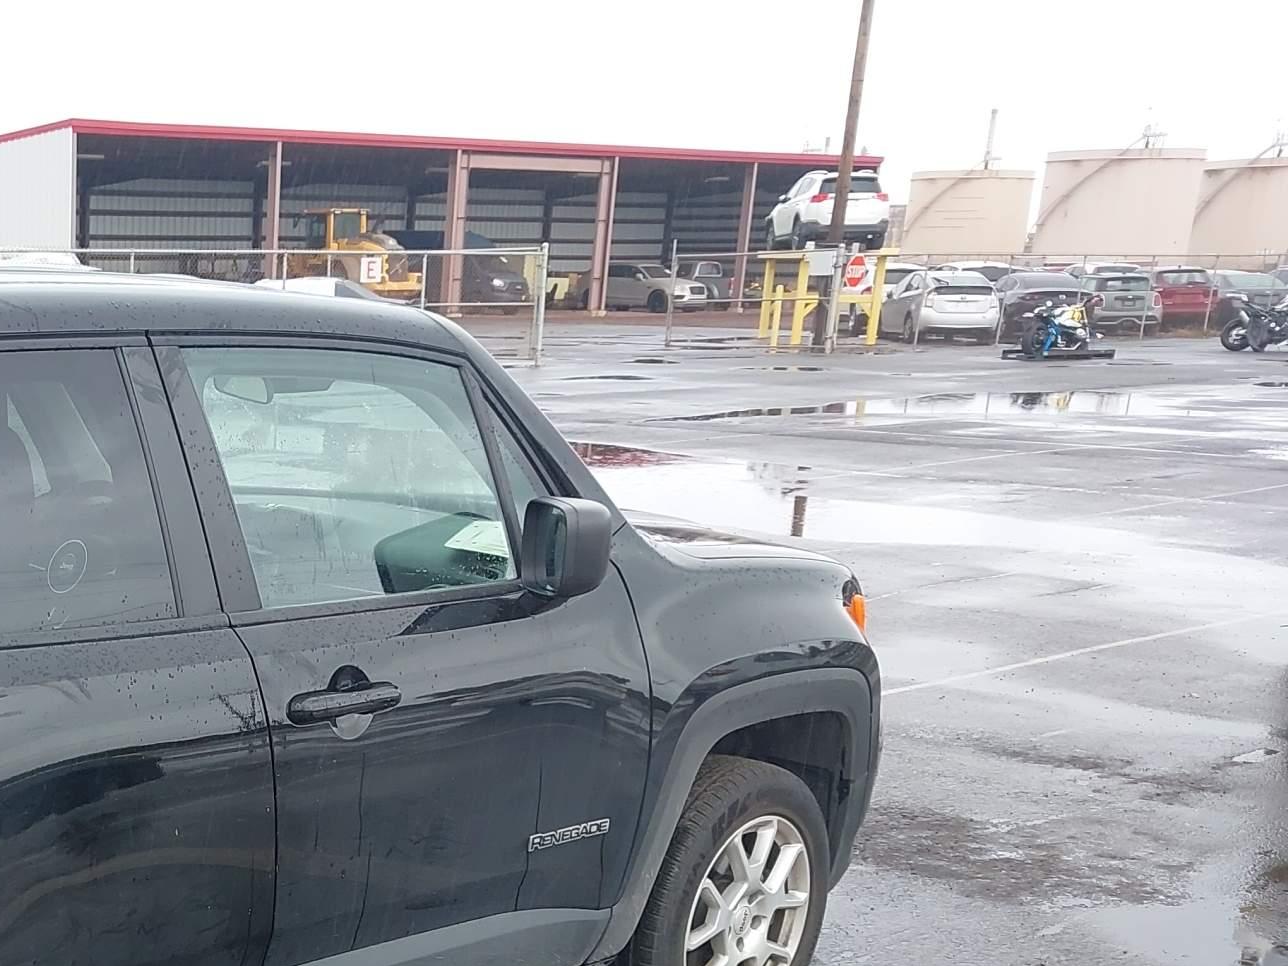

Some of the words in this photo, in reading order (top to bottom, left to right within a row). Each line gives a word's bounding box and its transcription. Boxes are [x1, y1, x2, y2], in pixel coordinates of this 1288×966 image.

[367, 261, 376, 279] E
[846, 264, 865, 278] STOP
[527, 818, 611, 852] RENEGADE
